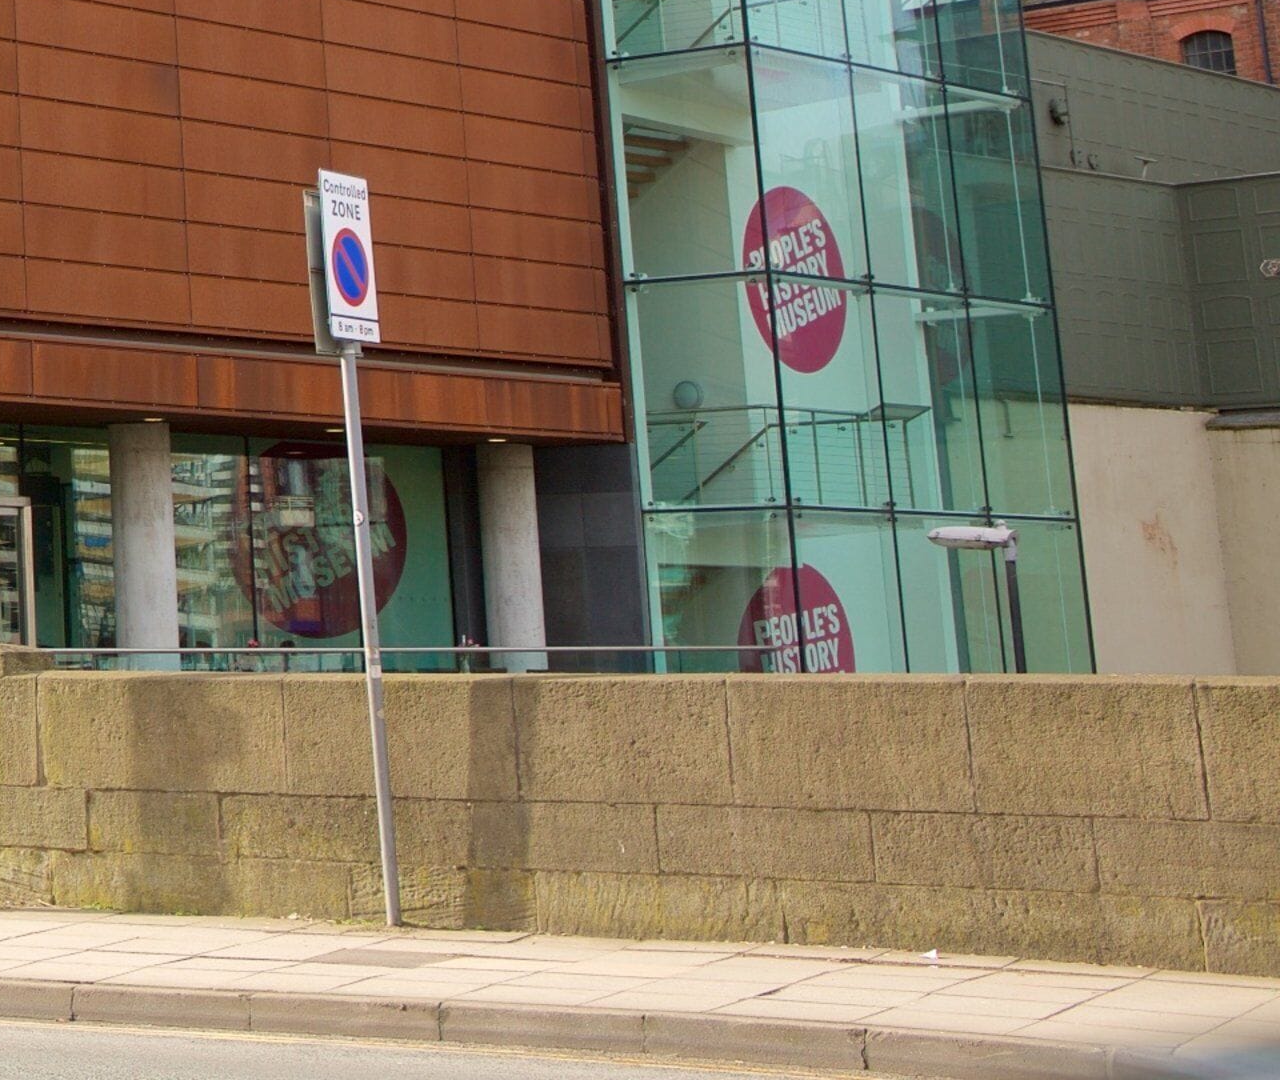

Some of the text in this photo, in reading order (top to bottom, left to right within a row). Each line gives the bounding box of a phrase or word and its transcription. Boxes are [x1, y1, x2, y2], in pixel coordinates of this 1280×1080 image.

[323, 178, 366, 200] Controlled
[331, 199, 361, 221] ZONE
[766, 287, 842, 339] MUSEUM
[264, 520, 398, 614] MUSEM
